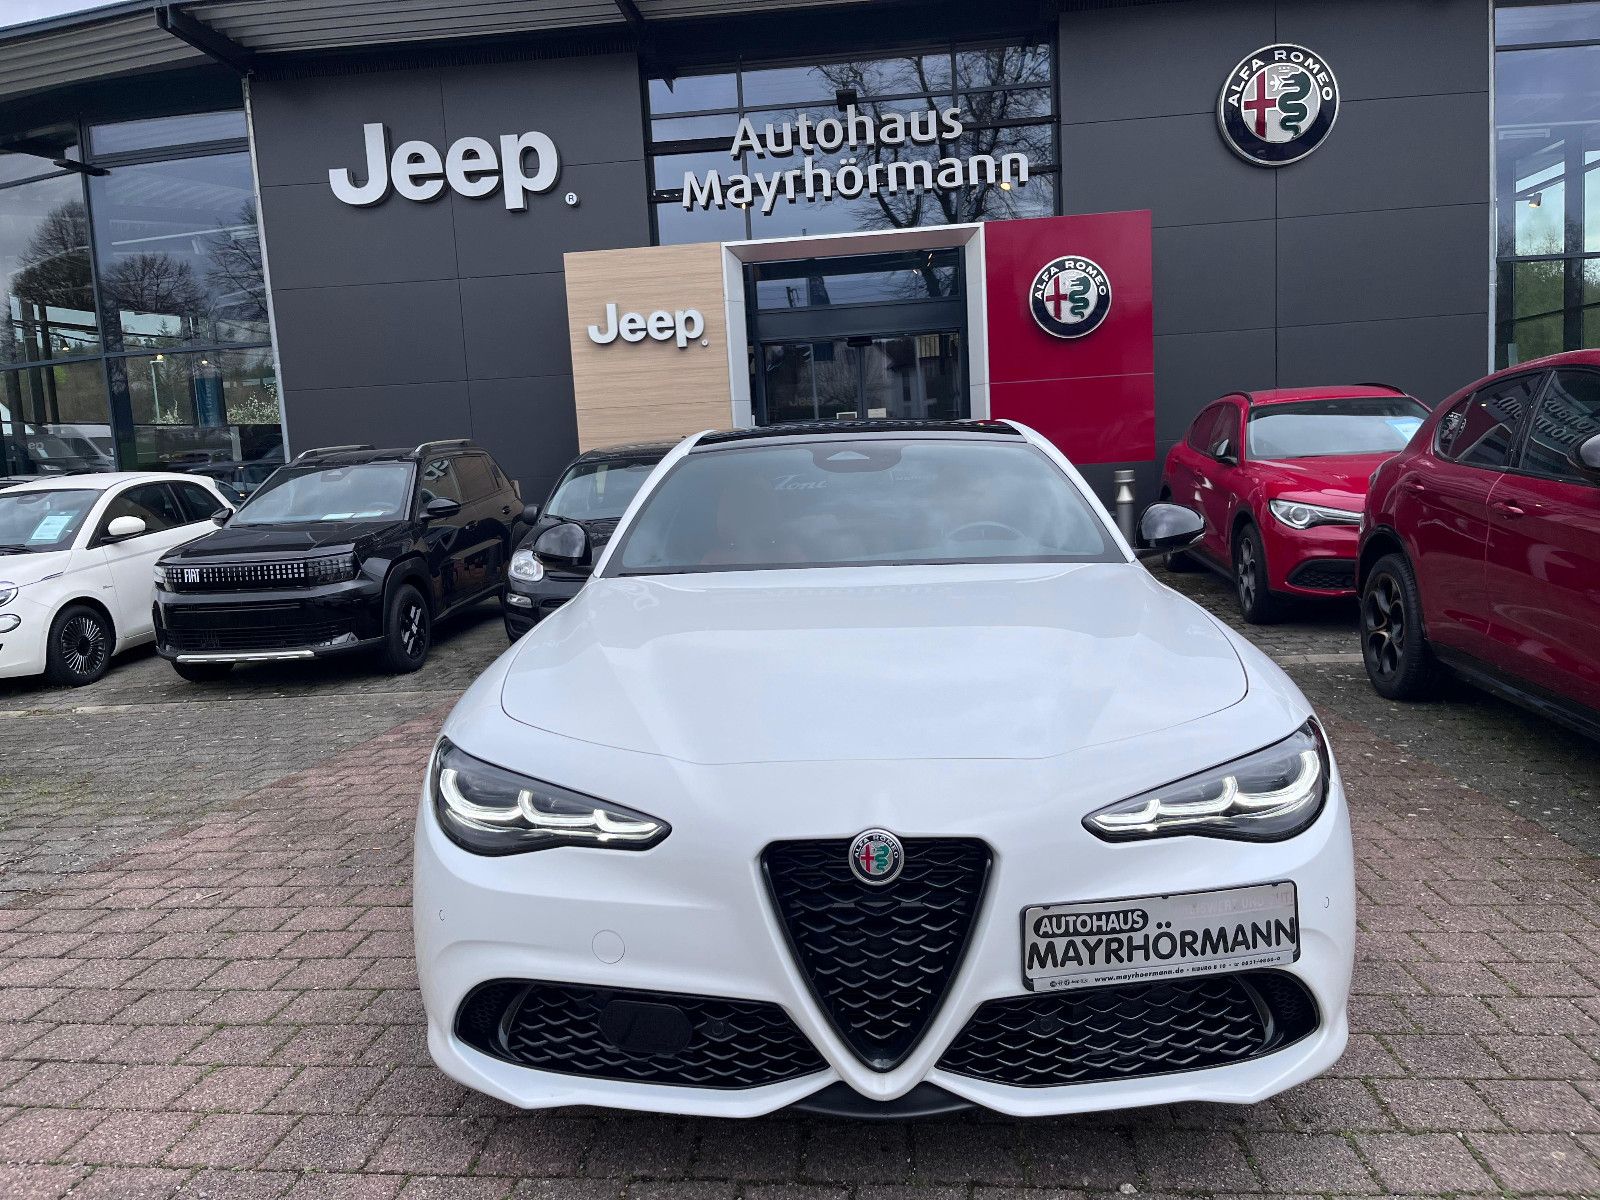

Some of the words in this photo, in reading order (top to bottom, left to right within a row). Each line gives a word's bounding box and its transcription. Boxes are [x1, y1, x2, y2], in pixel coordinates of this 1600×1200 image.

[1227, 58, 1265, 108] ALFA
[1274, 50, 1333, 101] ROMEO
[730, 105, 963, 158] Autohaus
[328, 122, 559, 210] Jeep
[682, 153, 1029, 213] Mayrhörmann
[1035, 266, 1060, 300] ALFA
[1064, 260, 1107, 296] ROMEO
[587, 303, 705, 348] Jeep
[183, 568, 200, 583] FIAT
[854, 838, 870, 859] ALFA
[872, 834, 899, 859] ROMEO
[1026, 916, 1296, 970] MAYRHÖRMANN
[1039, 910, 1144, 936] AUTOHAUS
[1094, 966, 1185, 983] www.mayrhoermann.de
